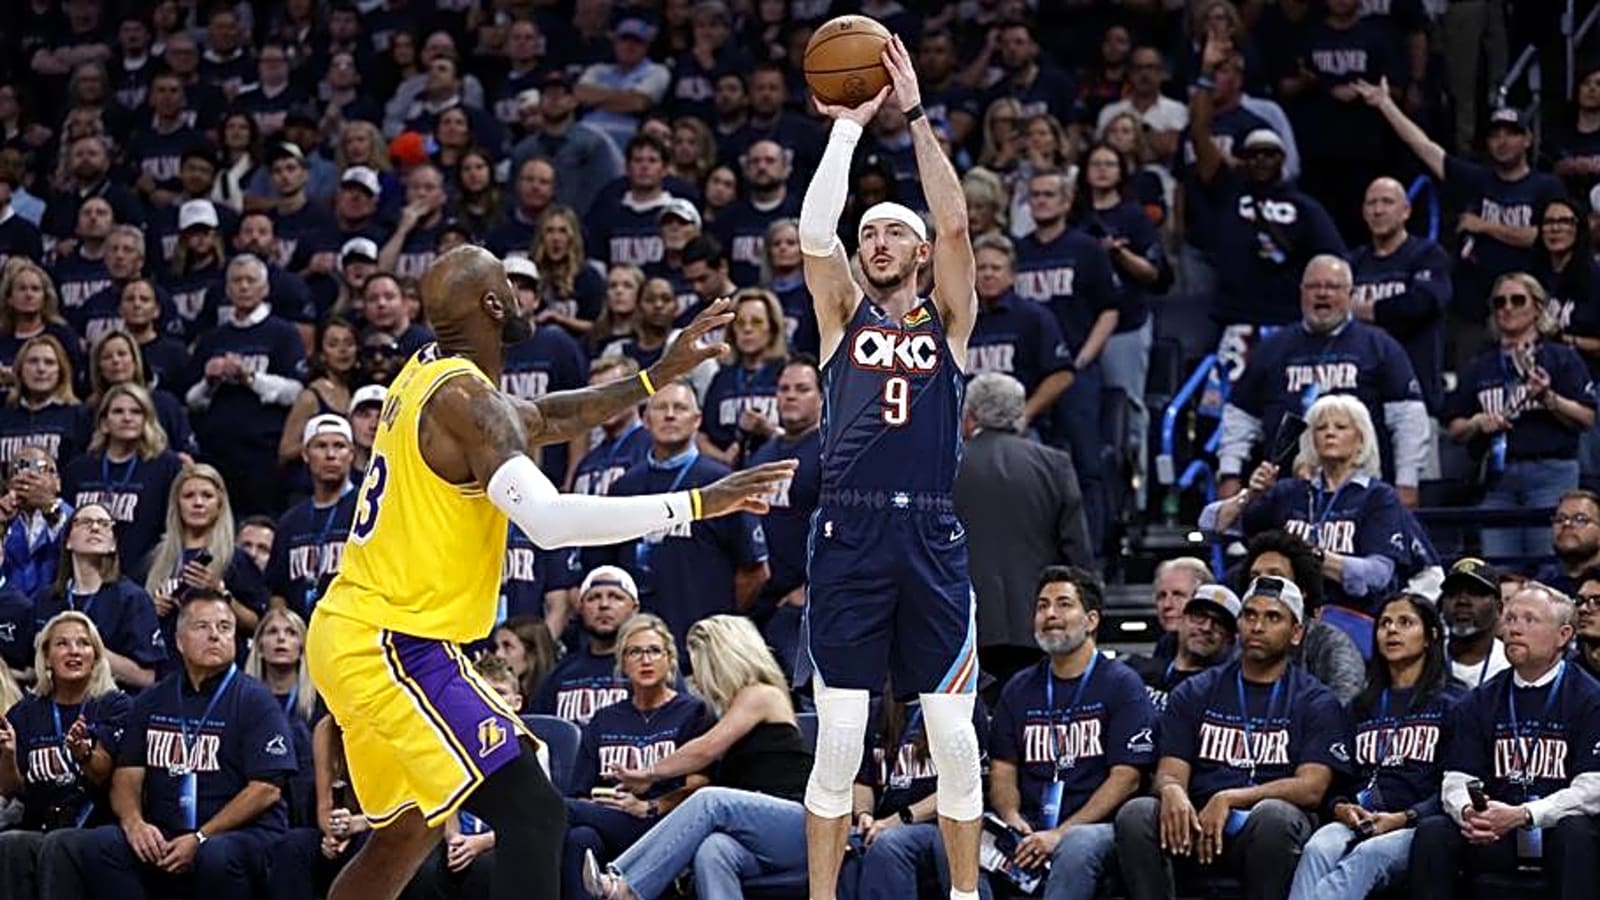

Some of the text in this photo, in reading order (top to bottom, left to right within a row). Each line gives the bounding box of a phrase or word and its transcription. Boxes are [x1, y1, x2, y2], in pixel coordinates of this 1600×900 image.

[854, 330, 937, 370] OKC
[884, 377, 908, 425] 9
[147, 729, 221, 774] THUNDER
[1199, 722, 1290, 766] THUNDER
